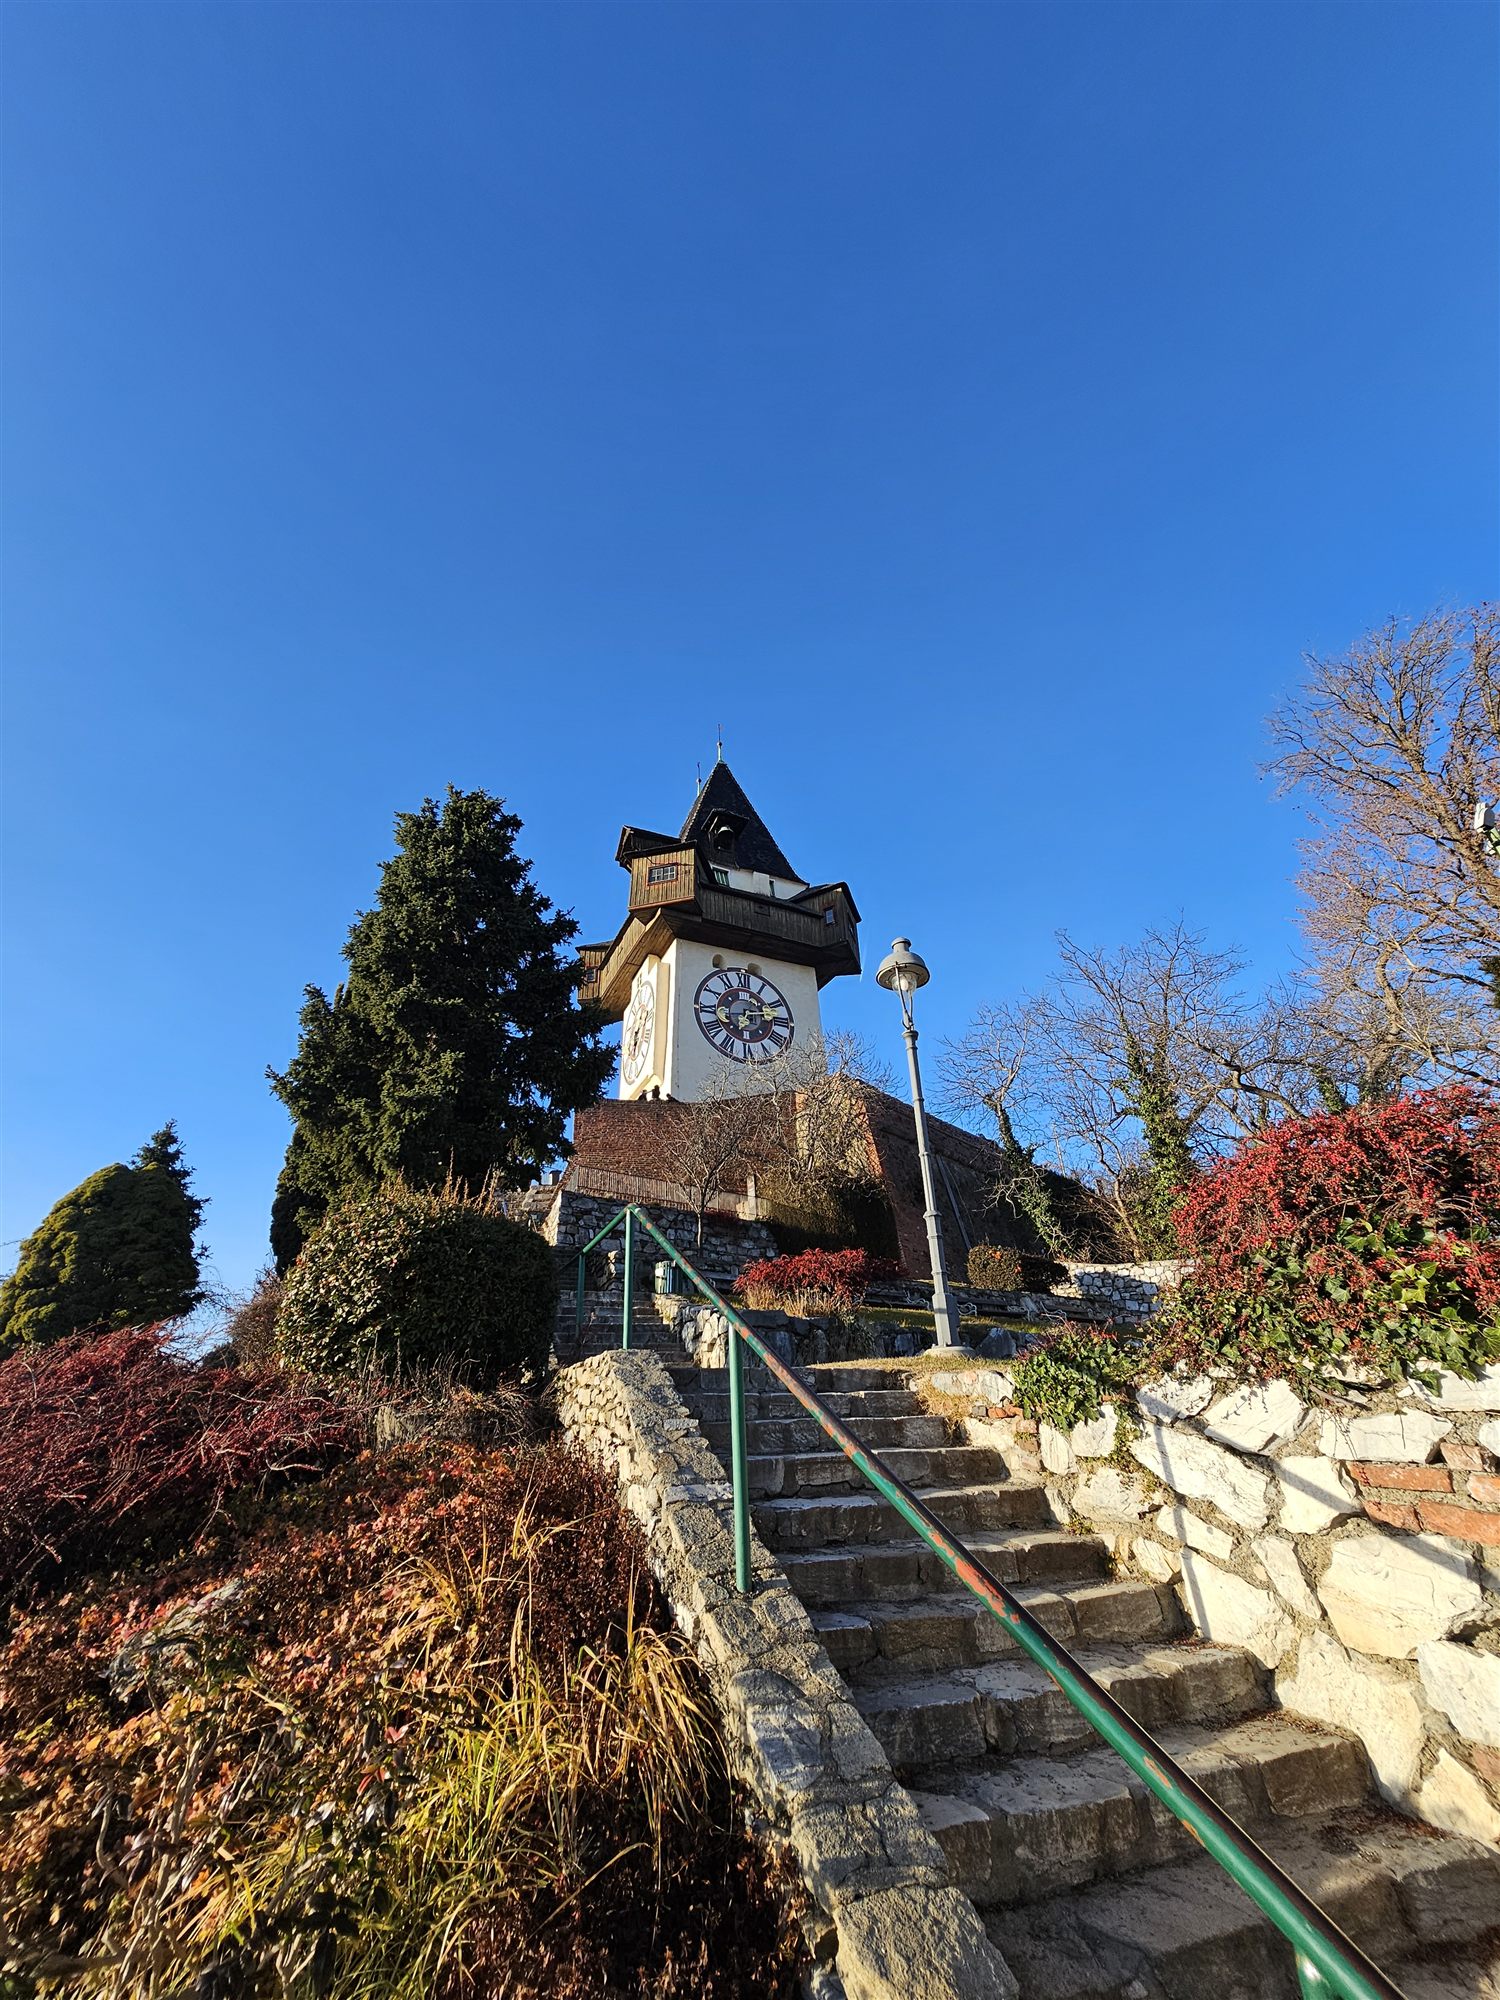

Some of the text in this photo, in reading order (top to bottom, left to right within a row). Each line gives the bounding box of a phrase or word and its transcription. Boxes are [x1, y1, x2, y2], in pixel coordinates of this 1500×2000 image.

[717, 973, 734, 990] XI
[736, 973, 751, 989] XII
[757, 982, 767, 995] I
[703, 984, 722, 999] X
[700, 1001, 717, 1014] IX
[703, 1020, 723, 1039] VIII
[774, 1017, 790, 1029] III
[719, 1033, 735, 1055] VII
